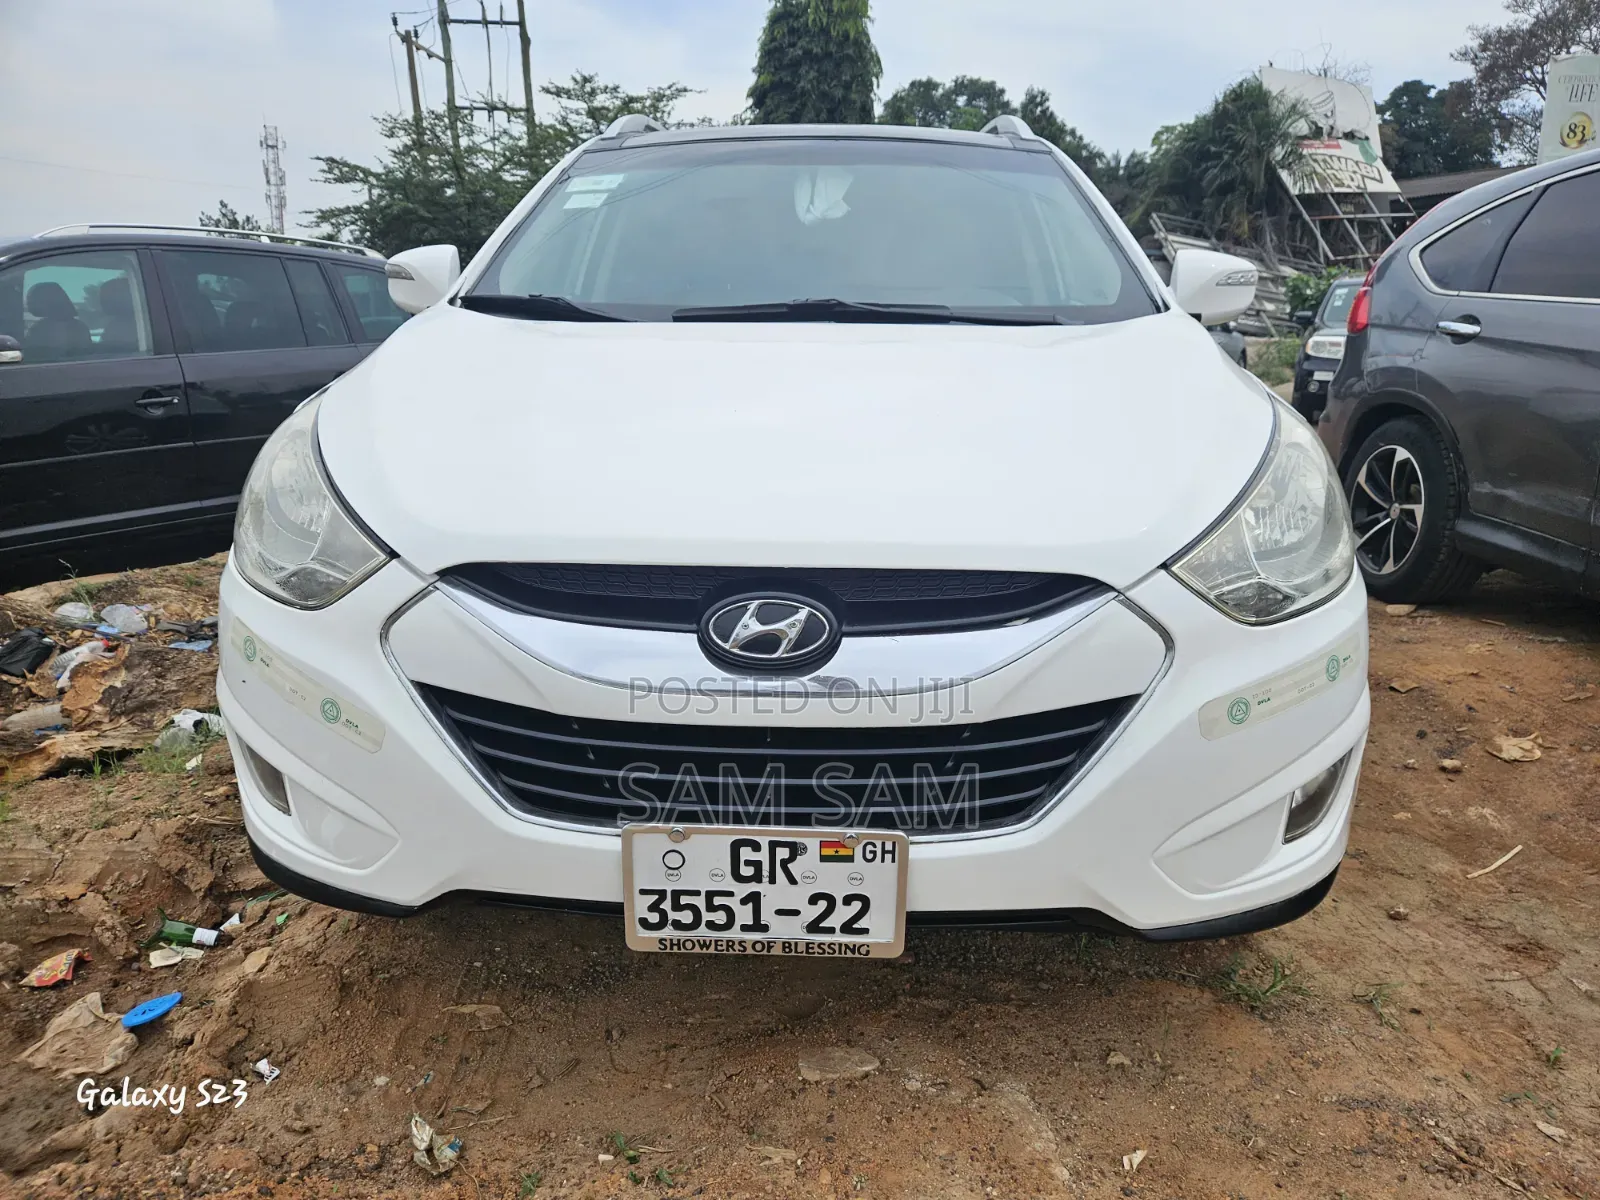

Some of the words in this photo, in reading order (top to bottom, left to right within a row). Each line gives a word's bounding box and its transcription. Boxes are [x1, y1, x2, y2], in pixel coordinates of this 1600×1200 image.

[1566, 122, 1586, 140] 83
[345, 718, 359, 729] DVLA
[730, 838, 799, 885] GR
[862, 841, 896, 863] GH
[638, 888, 871, 935] 3551-22
[658, 938, 747, 953] SHOWERS
[751, 940, 776, 954] OF
[782, 941, 870, 957] BLESSING
